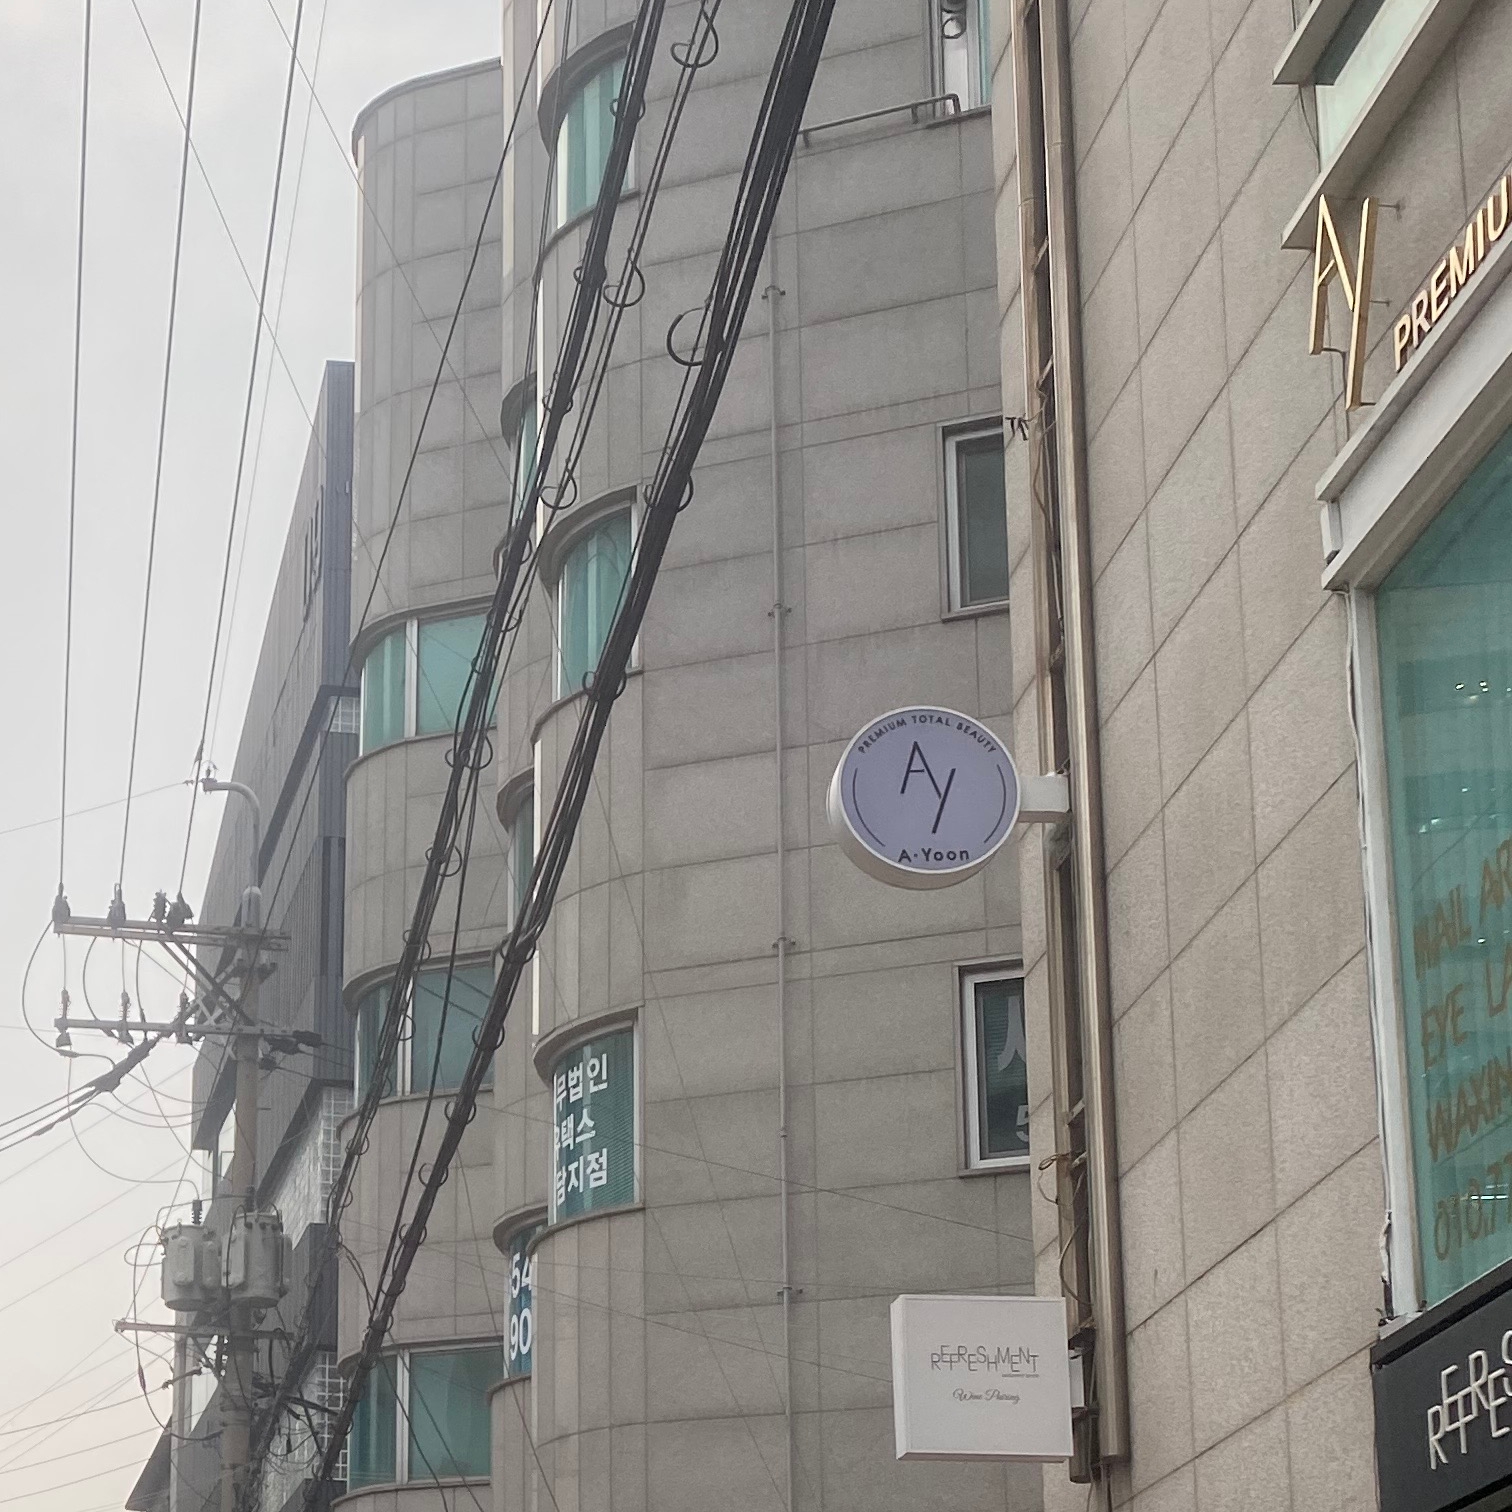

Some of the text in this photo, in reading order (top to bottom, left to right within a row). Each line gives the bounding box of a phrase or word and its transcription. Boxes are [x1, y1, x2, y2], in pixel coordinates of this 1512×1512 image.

[858, 715, 996, 753] PREMIUM TOTAL BEAUTY
[931, 1345, 1039, 1373] REFRESHMENT
